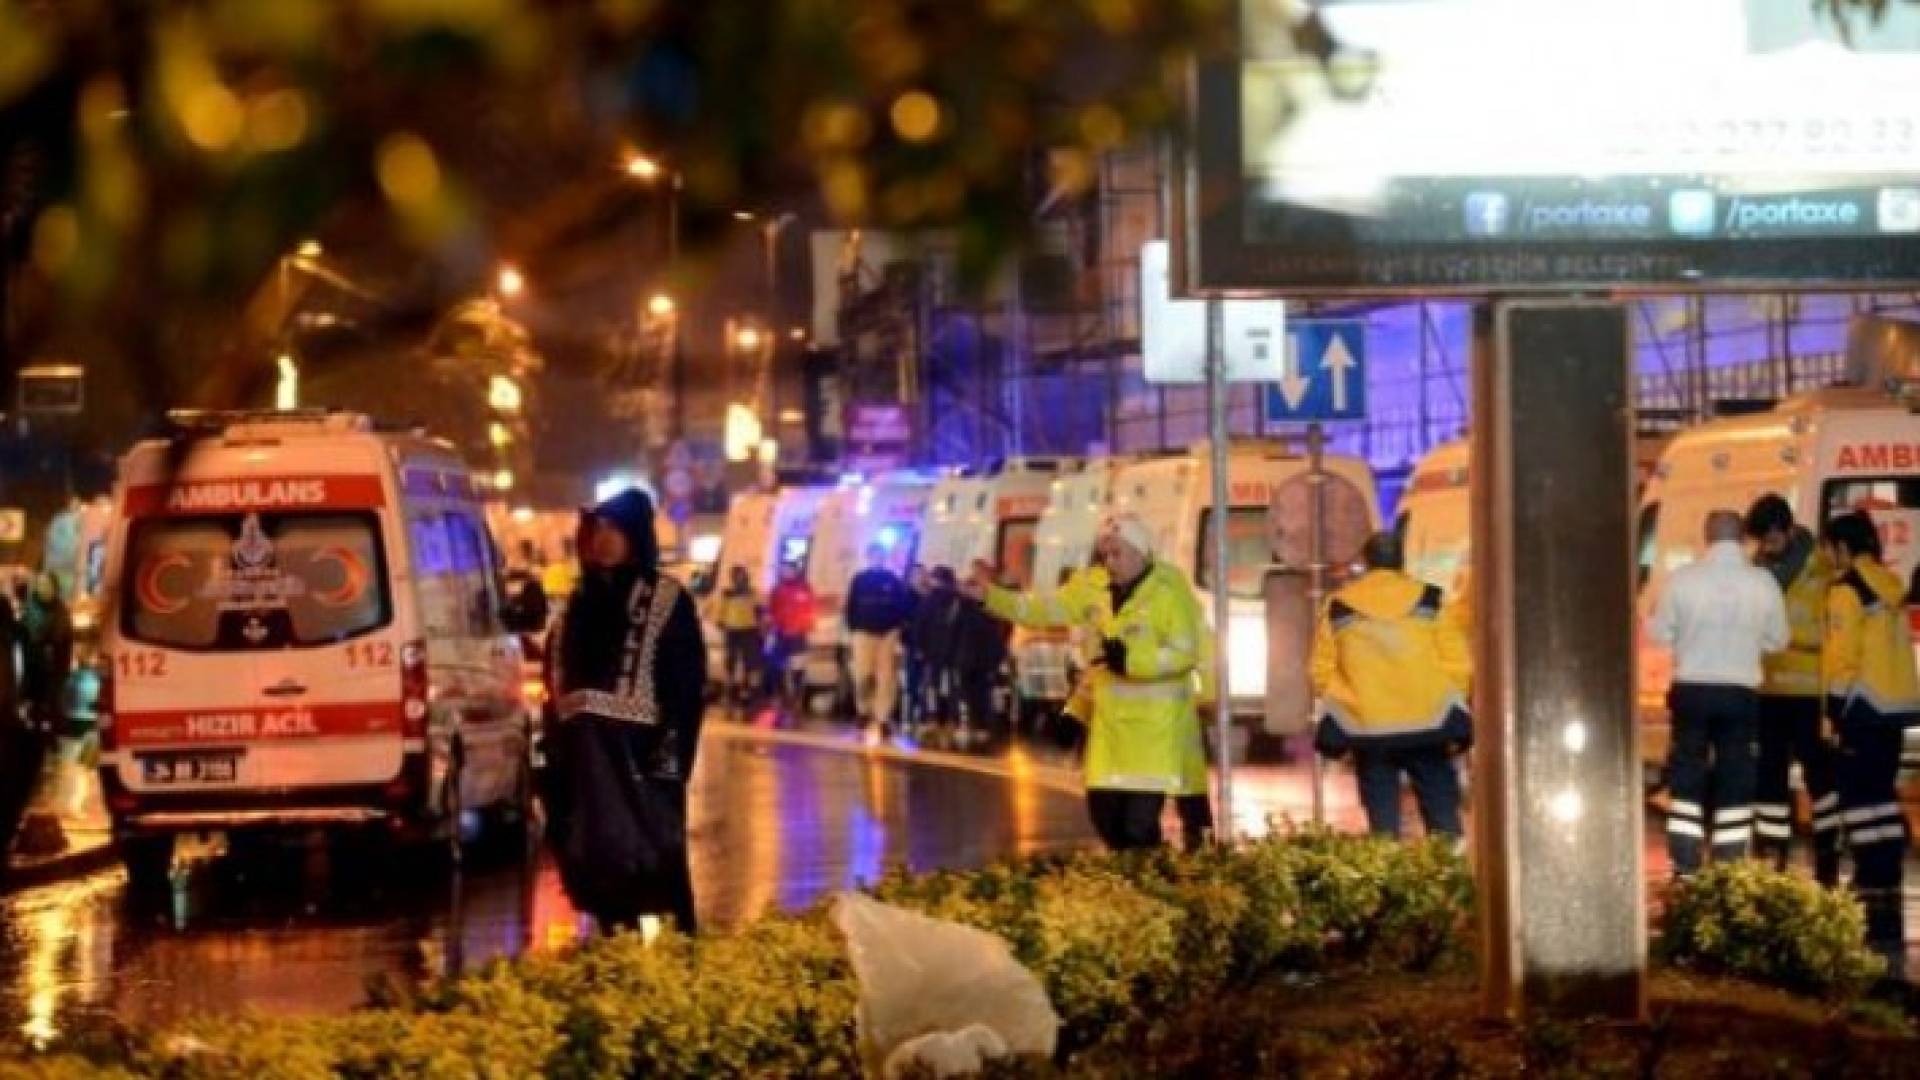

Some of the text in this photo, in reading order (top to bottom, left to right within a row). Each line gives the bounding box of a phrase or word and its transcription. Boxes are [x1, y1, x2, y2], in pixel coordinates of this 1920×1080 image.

[1725, 194, 1860, 228] /portaxe
[170, 480, 326, 507] AMBULANS
[117, 652, 167, 677] 112
[344, 643, 392, 667] 112
